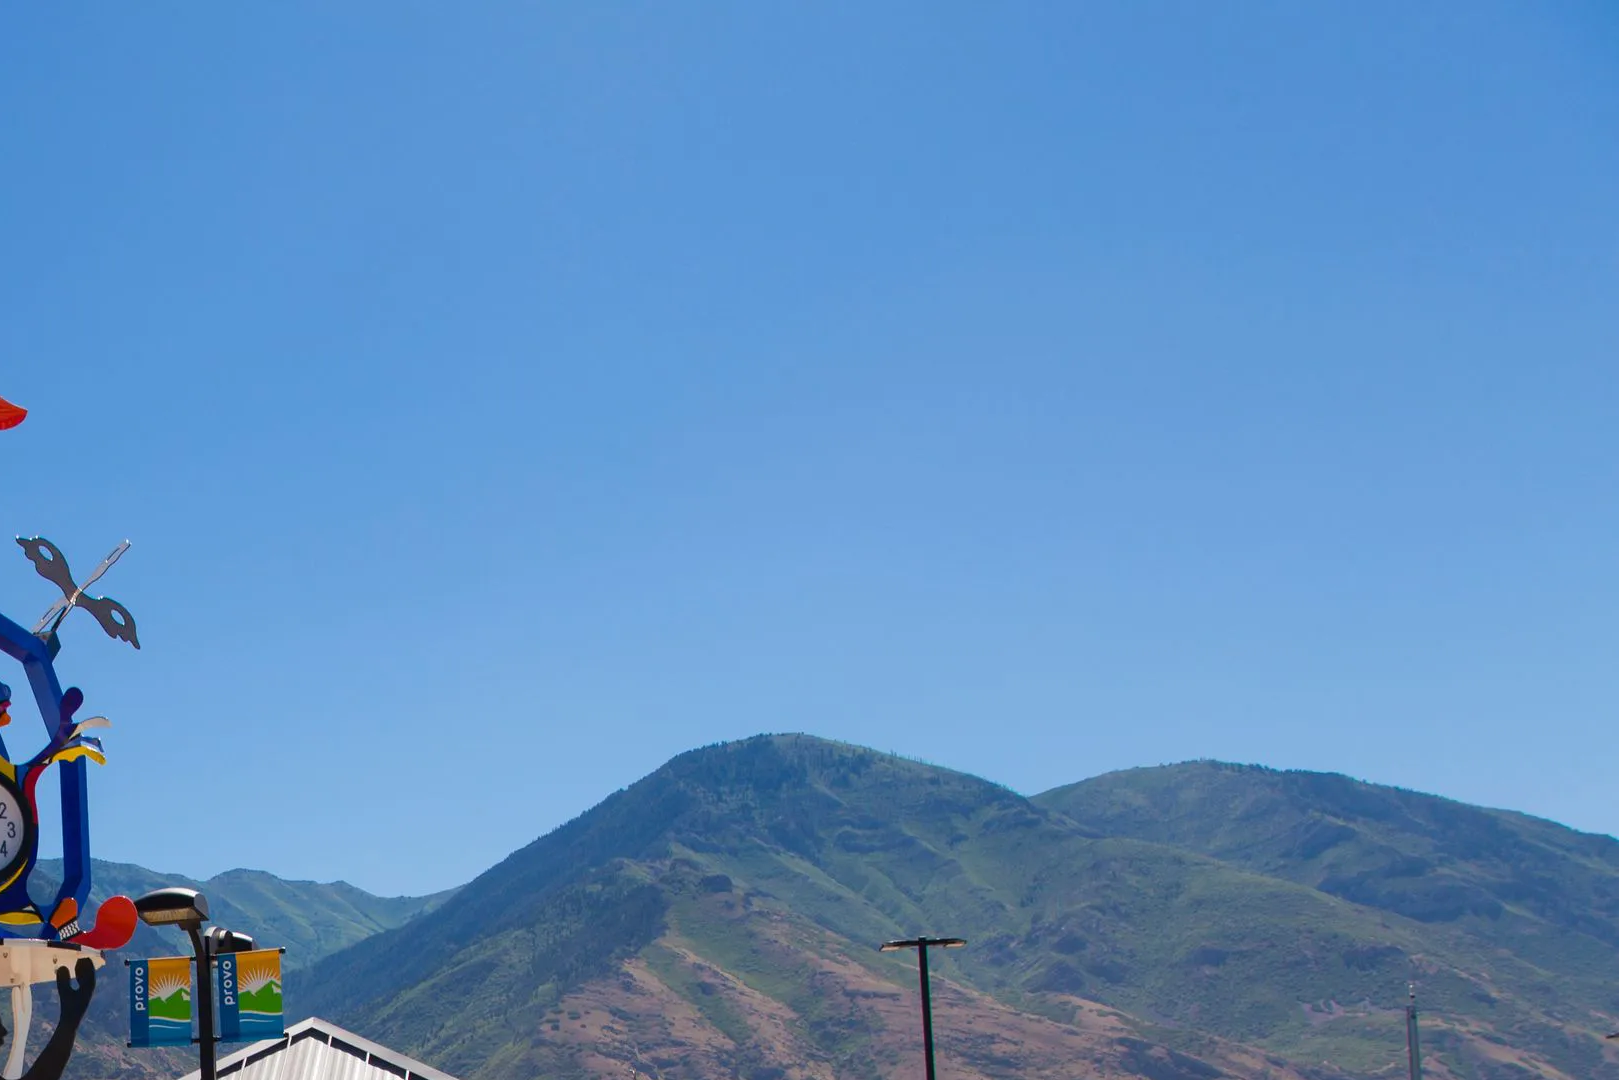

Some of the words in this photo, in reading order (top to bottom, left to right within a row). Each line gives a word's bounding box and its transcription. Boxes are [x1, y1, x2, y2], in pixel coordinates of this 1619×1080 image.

[7, 821, 16, 838] 3
[0, 840, 8, 857] 4
[135, 967, 146, 1011] provo
[222, 960, 236, 1005] provo
